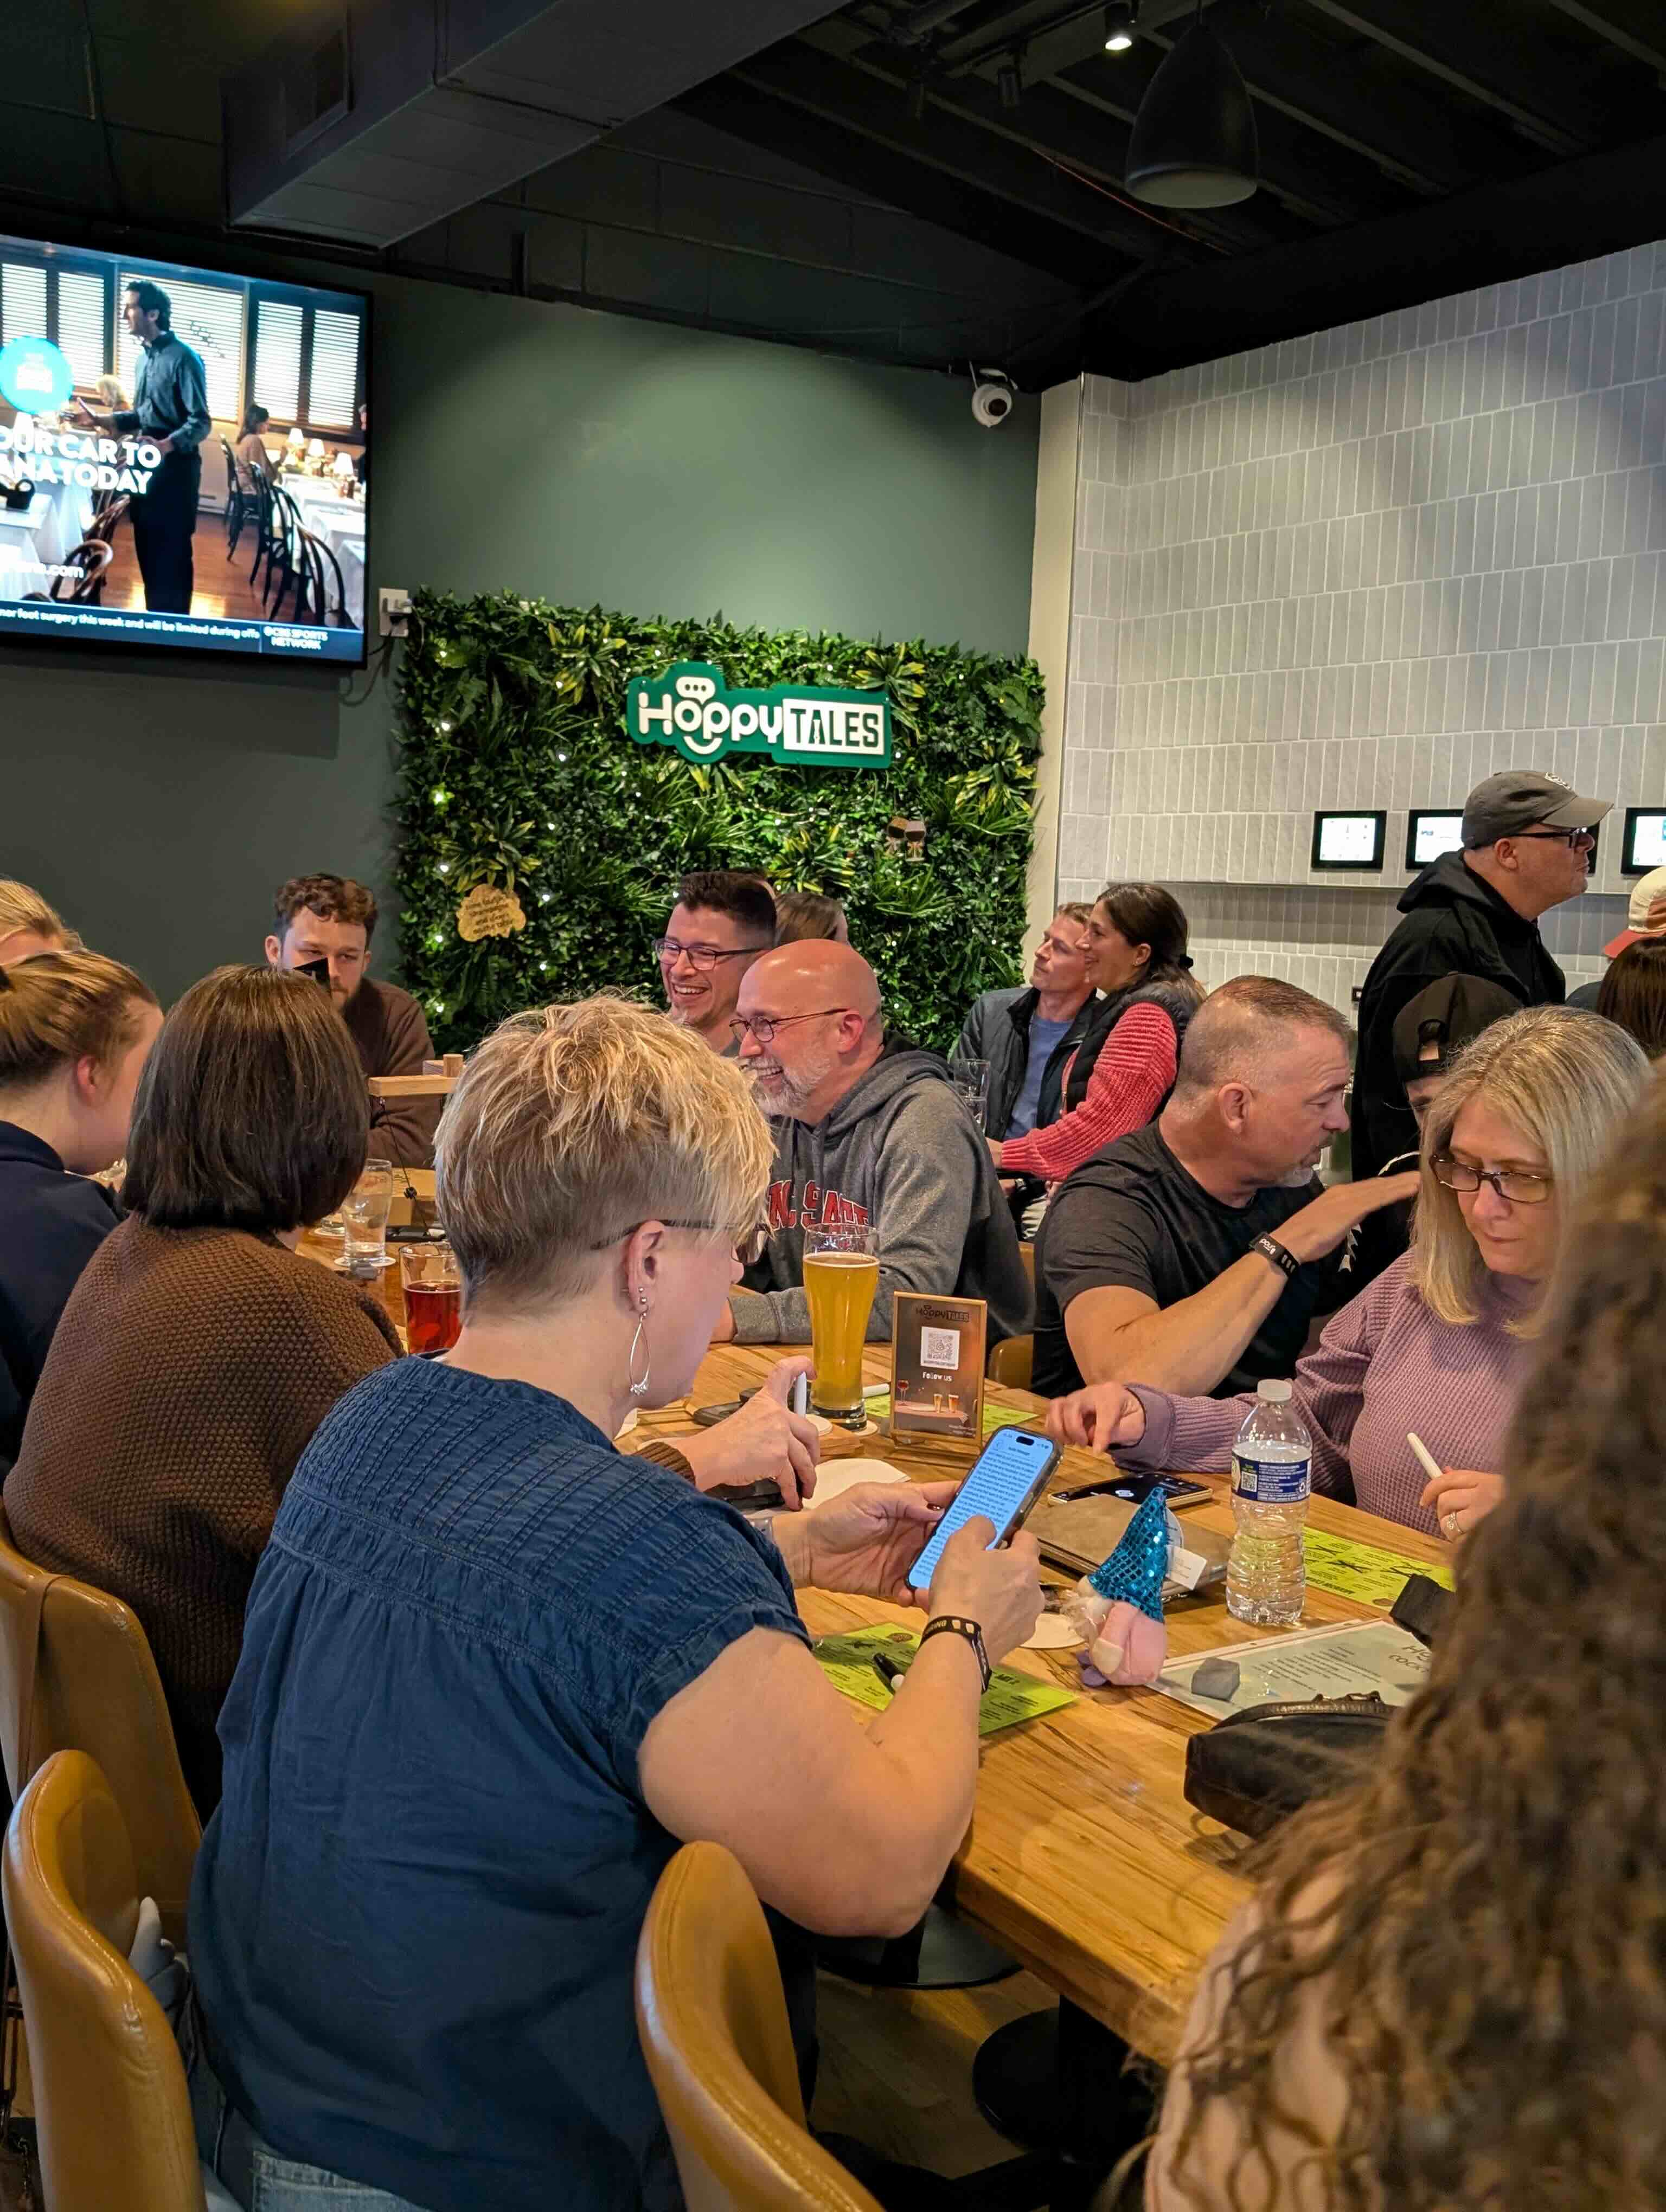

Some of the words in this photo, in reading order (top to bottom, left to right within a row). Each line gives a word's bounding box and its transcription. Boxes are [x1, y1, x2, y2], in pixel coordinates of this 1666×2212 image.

[58, 434, 118, 465] CAR
[121, 441, 162, 468] TO
[60, 462, 152, 494] TODAY
[17, 608, 40, 620] foot
[40, 612, 78, 625] surgery
[79, 614, 98, 625] this
[98, 617, 124, 627] week
[125, 619, 144, 629] and
[145, 620, 162, 630] will
[162, 621, 175, 631] be
[175, 622, 209, 634] limited
[210, 625, 241, 639] during
[291, 629, 328, 641] SPORTS
[271, 636, 322, 651] NETWORK
[790, 708, 880, 748] TALES
[922, 1371, 943, 1380] Follow
